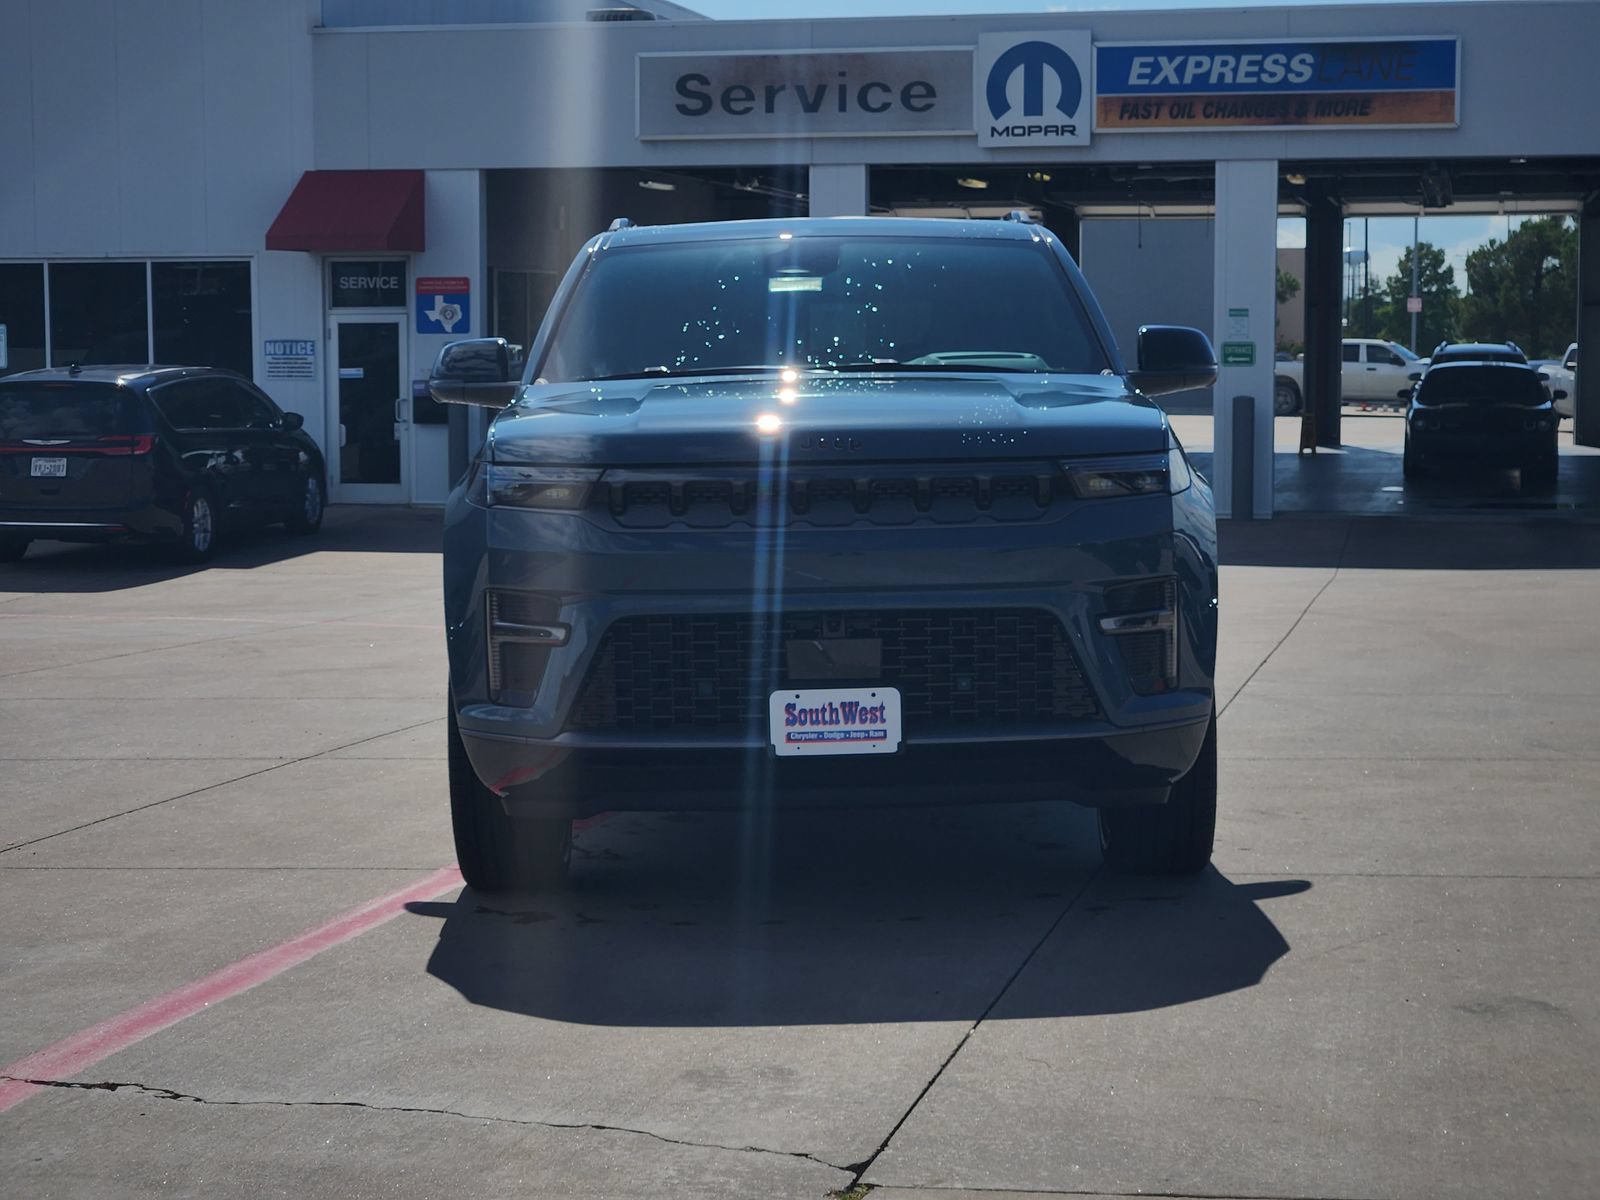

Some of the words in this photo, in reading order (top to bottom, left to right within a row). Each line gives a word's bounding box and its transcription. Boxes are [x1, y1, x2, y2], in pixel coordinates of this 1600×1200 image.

[1128, 54, 1314, 85] EXPRESS
[1317, 50, 1416, 82] LANE
[675, 73, 936, 116] Service
[1119, 102, 1165, 120] FAST
[1169, 102, 1196, 119] OIL
[1203, 101, 1290, 118] CHANGES
[1314, 98, 1373, 117] MORE
[990, 125, 1076, 138] MOPAR
[339, 276, 399, 289] SERVICE
[265, 342, 313, 355] NOTICE
[790, 732, 818, 741] Chrysler
[823, 731, 844, 740] Dodge
[850, 730, 865, 739] Jeep
[869, 730, 884, 738] Ram
